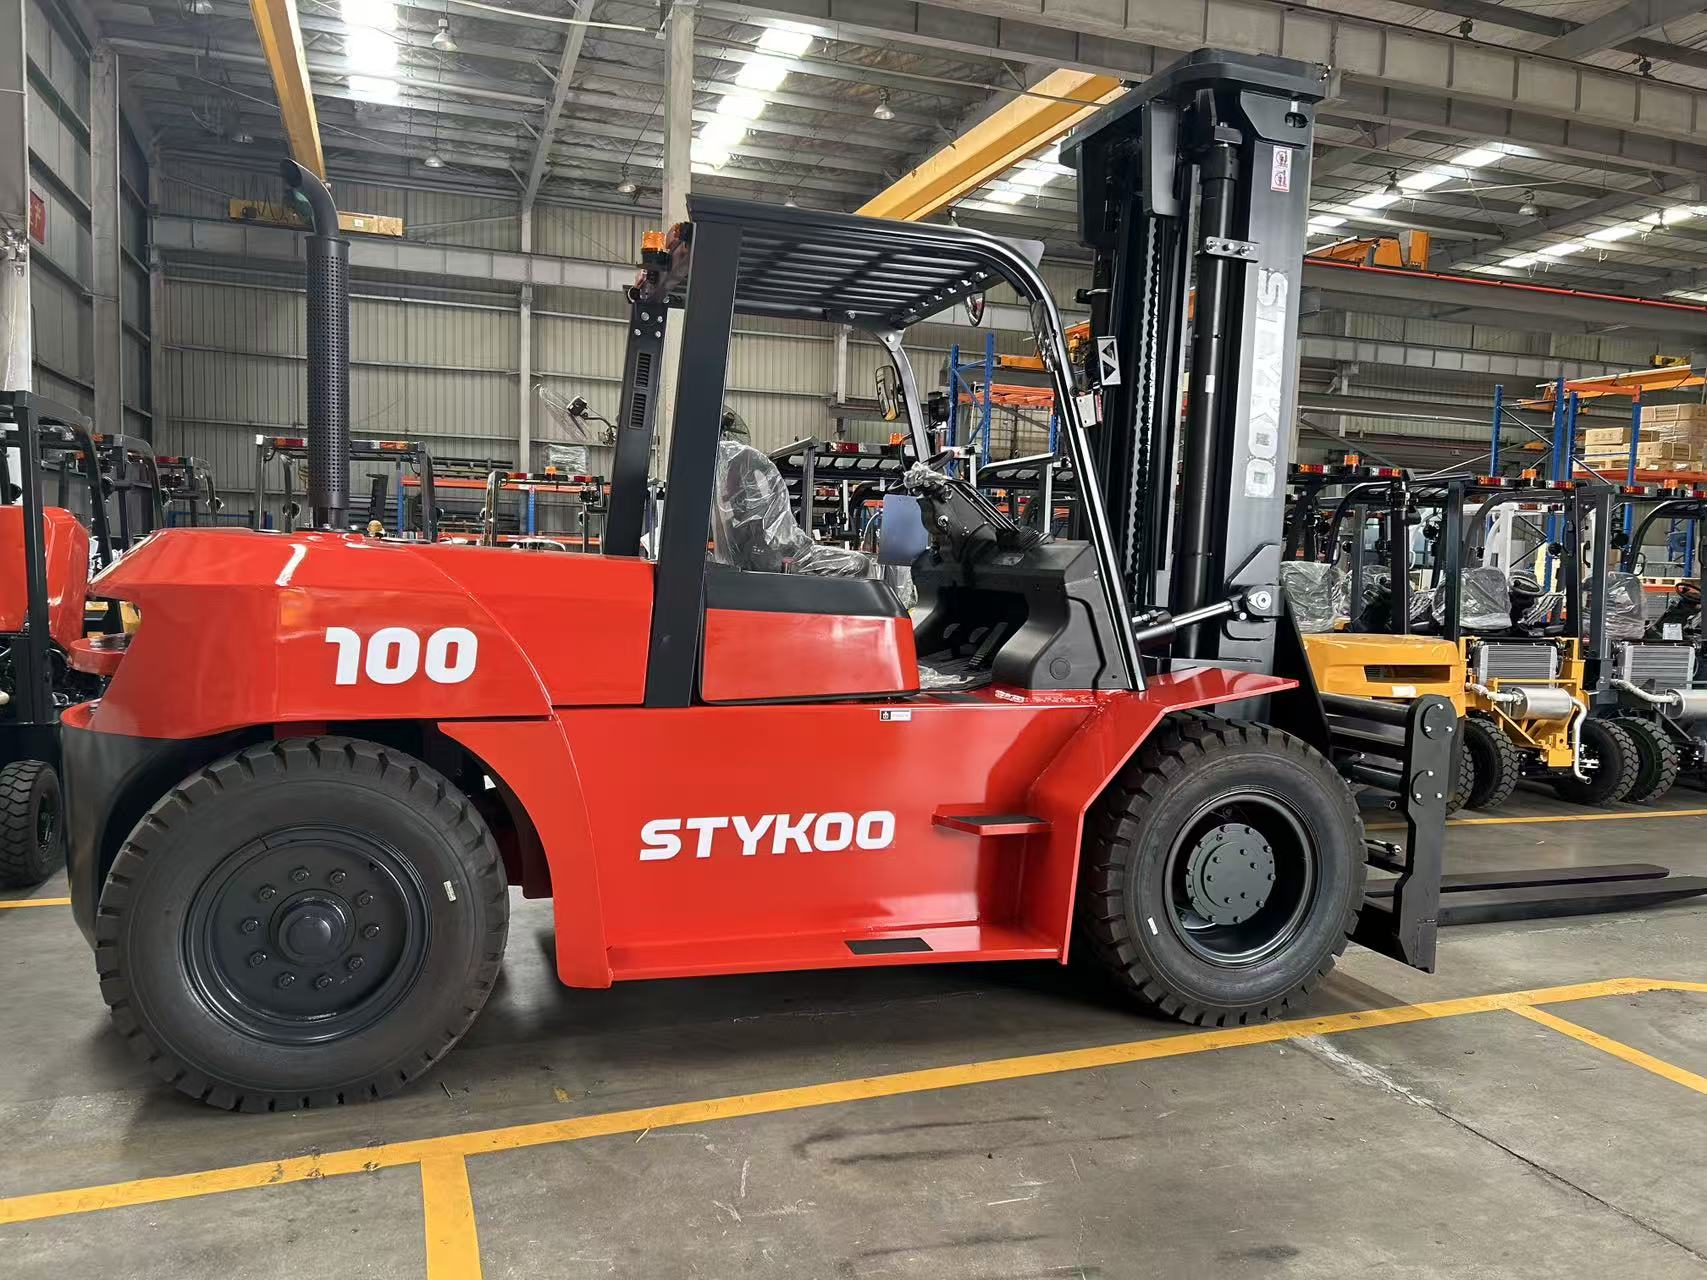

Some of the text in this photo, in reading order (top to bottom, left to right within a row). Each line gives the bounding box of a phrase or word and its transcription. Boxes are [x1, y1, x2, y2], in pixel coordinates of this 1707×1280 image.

[1245, 269, 1288, 498] STYKOO
[325, 626, 478, 685] 100
[639, 810, 896, 861] STYKOO
